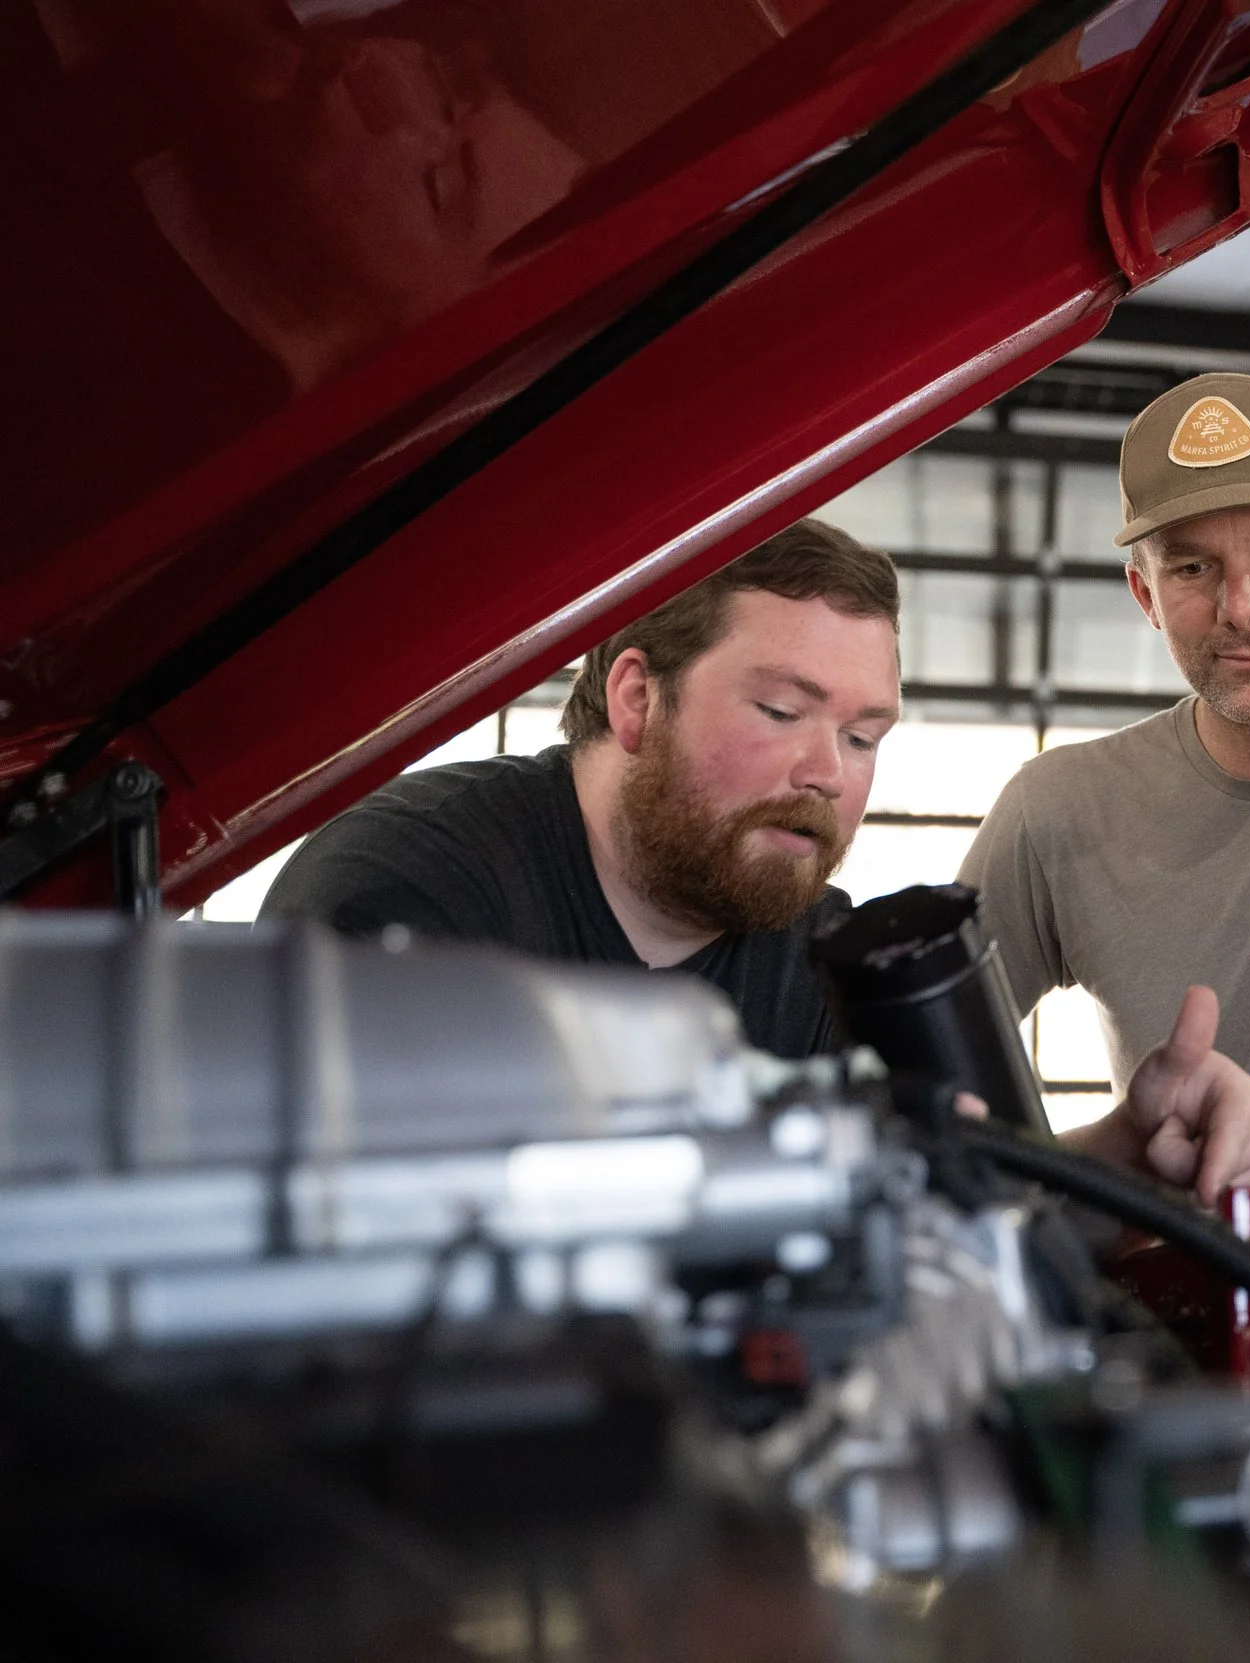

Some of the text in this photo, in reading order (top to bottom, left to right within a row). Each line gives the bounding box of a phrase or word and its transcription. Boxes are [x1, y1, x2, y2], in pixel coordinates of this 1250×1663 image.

[1181, 435, 1250, 455] MARFA SPIRIT CO
